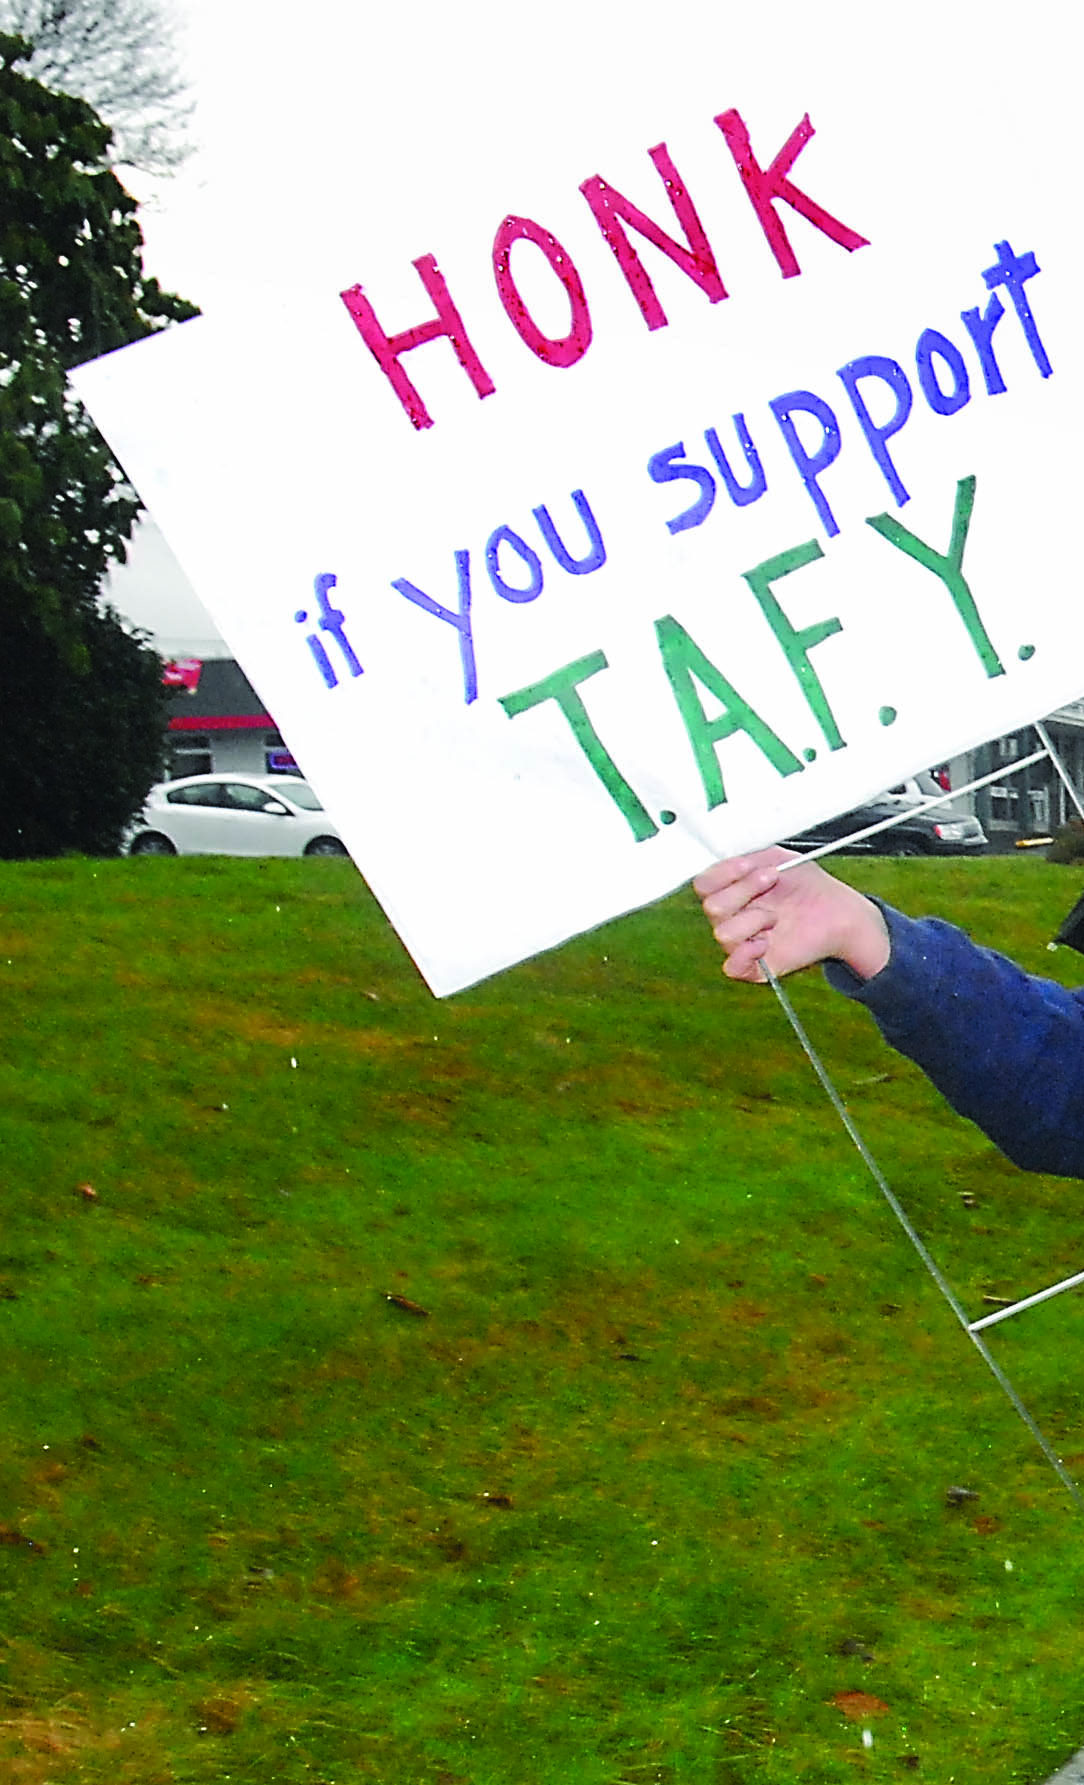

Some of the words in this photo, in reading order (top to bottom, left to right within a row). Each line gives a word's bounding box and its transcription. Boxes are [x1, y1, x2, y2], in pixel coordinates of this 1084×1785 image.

[340, 107, 873, 431] HONK
[293, 572, 364, 689] if
[390, 488, 608, 705] you
[646, 239, 1054, 538] support
[496, 474, 1036, 843] T.A.F.Y.
